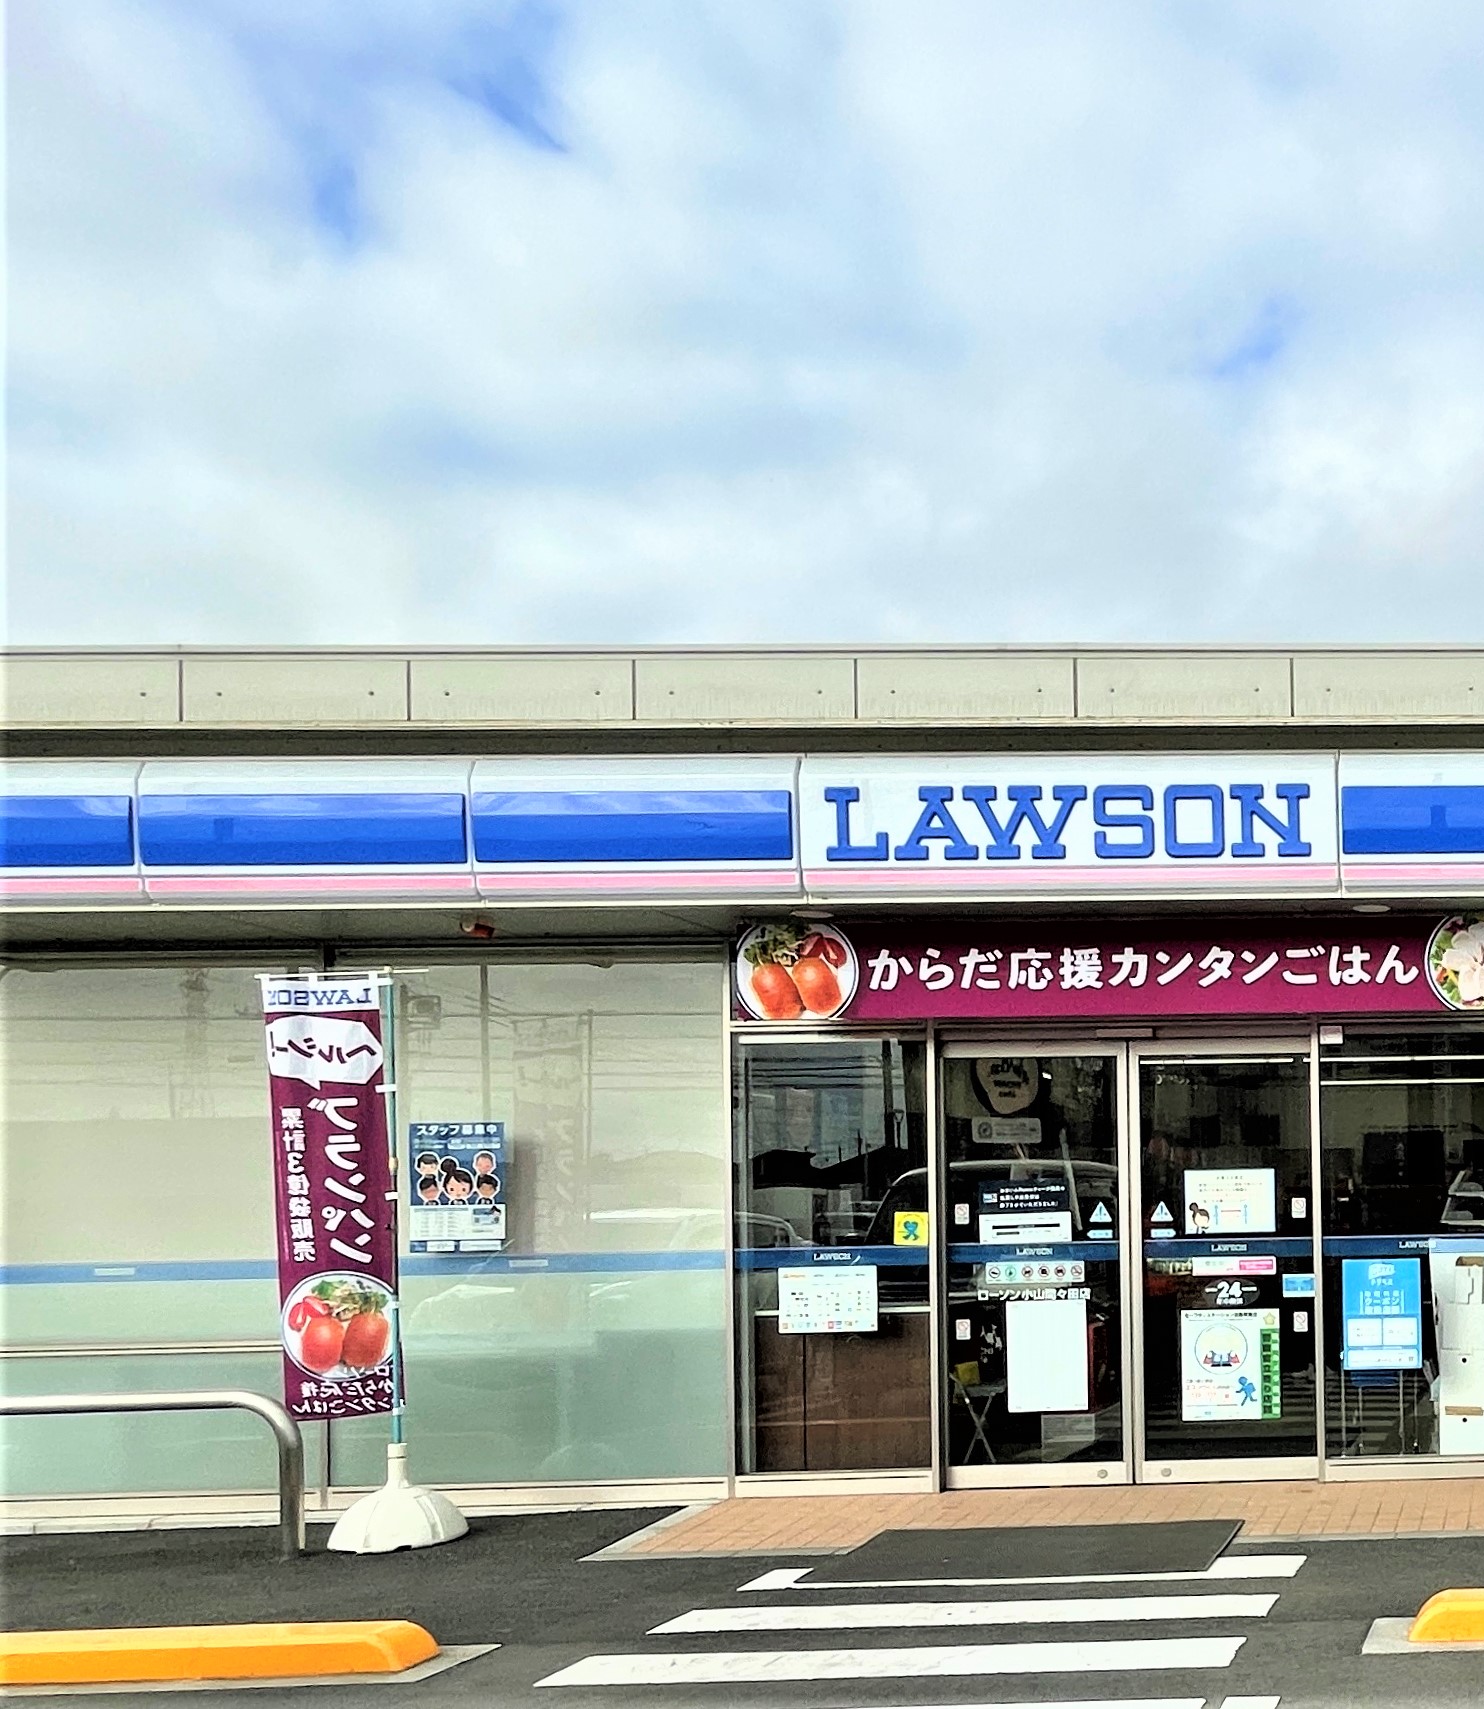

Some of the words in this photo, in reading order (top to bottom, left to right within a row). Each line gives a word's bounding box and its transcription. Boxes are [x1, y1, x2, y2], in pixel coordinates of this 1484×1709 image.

[824, 783, 1312, 863] LAWSON
[867, 944, 1420, 993] からだ応援カンタンごはん
